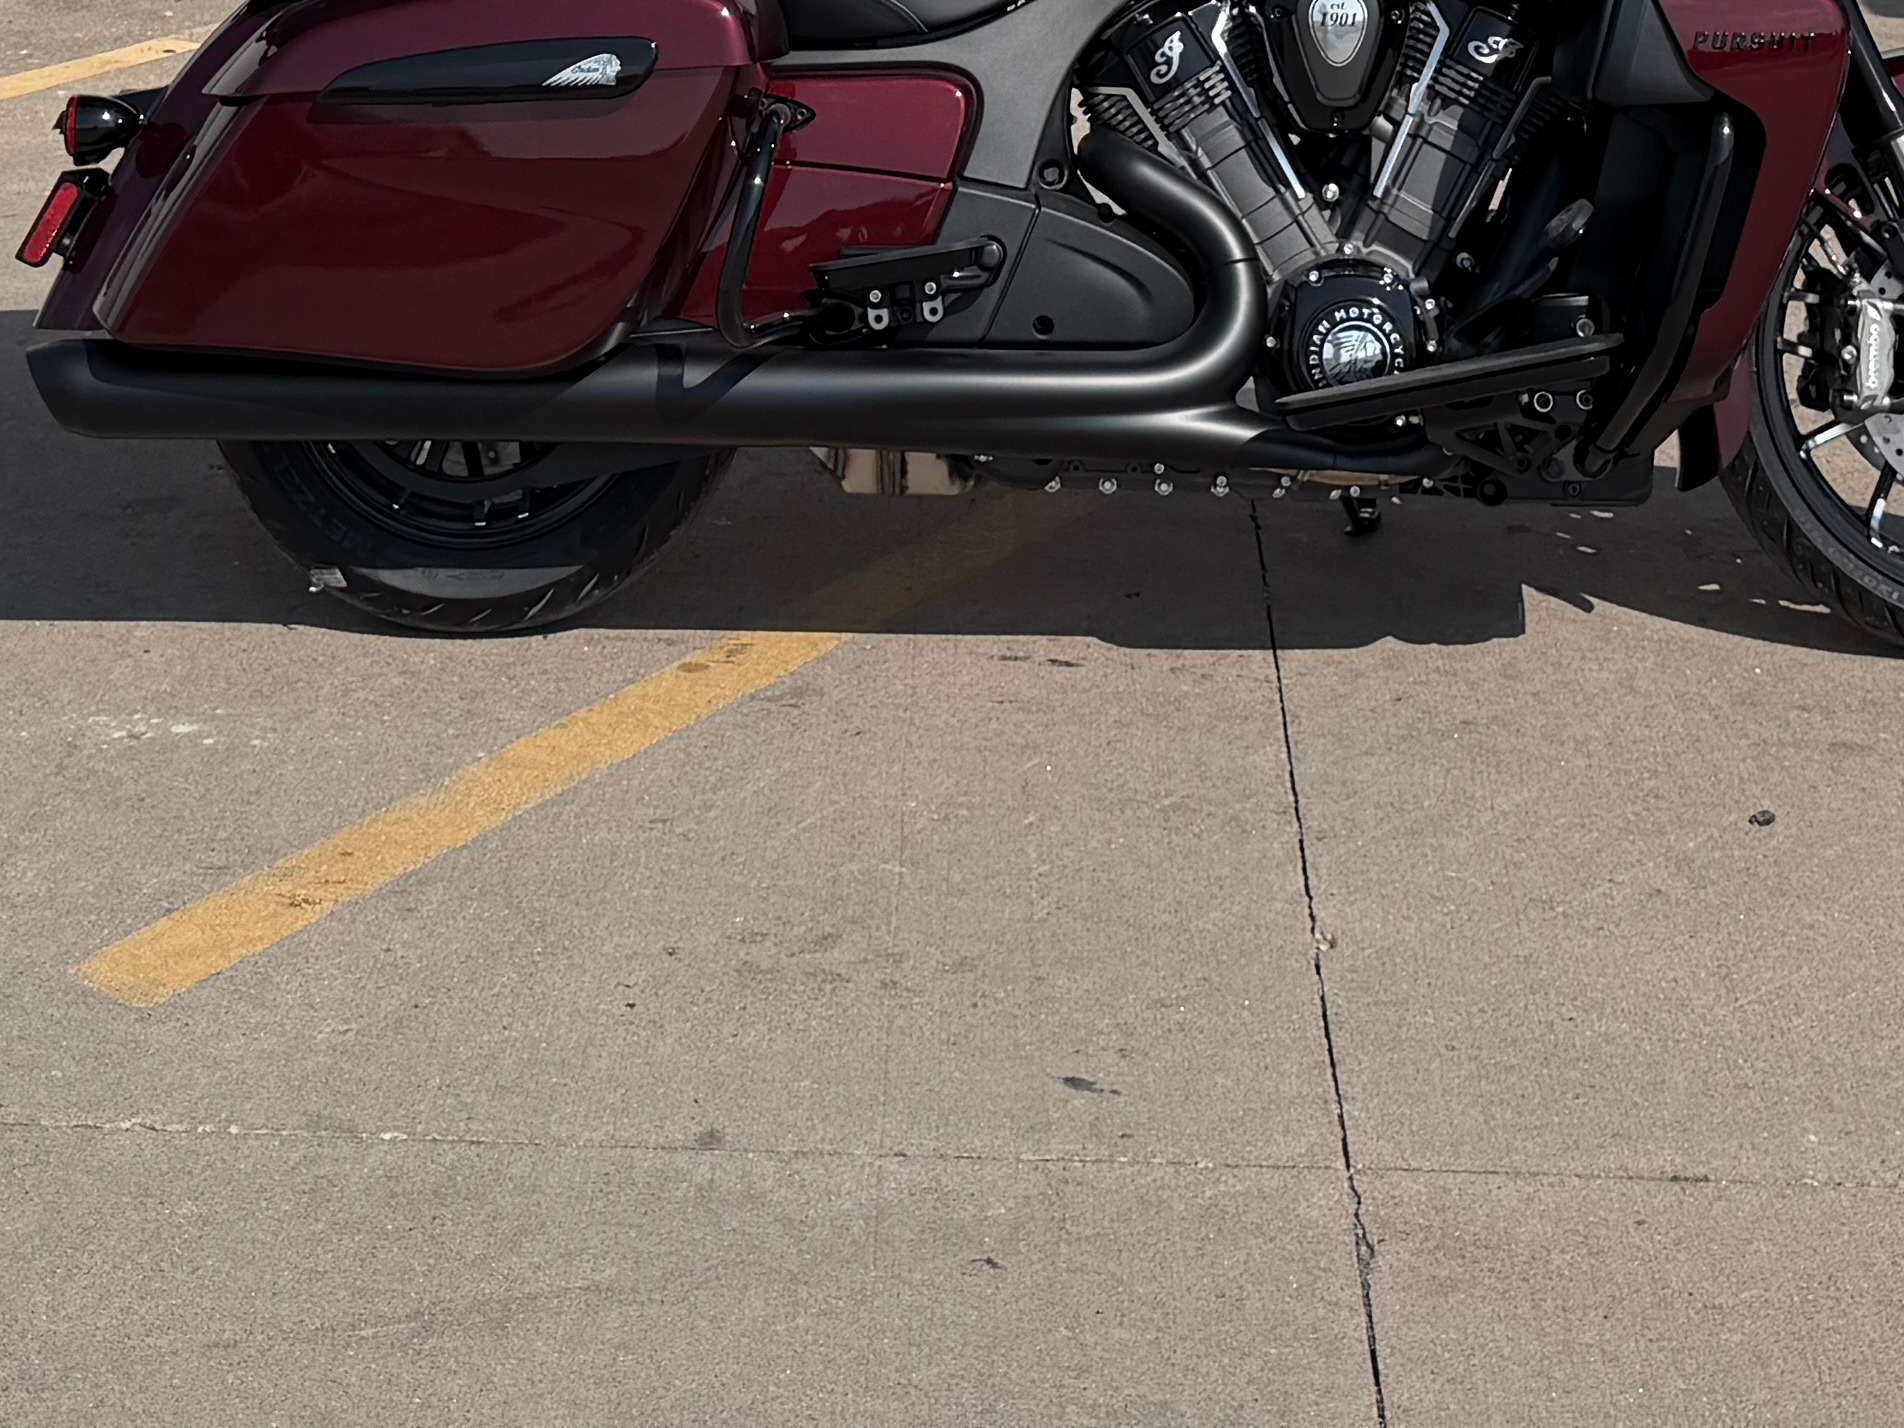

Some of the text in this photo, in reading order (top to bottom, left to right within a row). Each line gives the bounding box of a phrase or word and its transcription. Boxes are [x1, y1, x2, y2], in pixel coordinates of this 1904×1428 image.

[1320, 11, 1358, 27] 1901
[1692, 31, 1815, 53] PURSUIT
[1334, 307, 1405, 374] MOTORCYC
